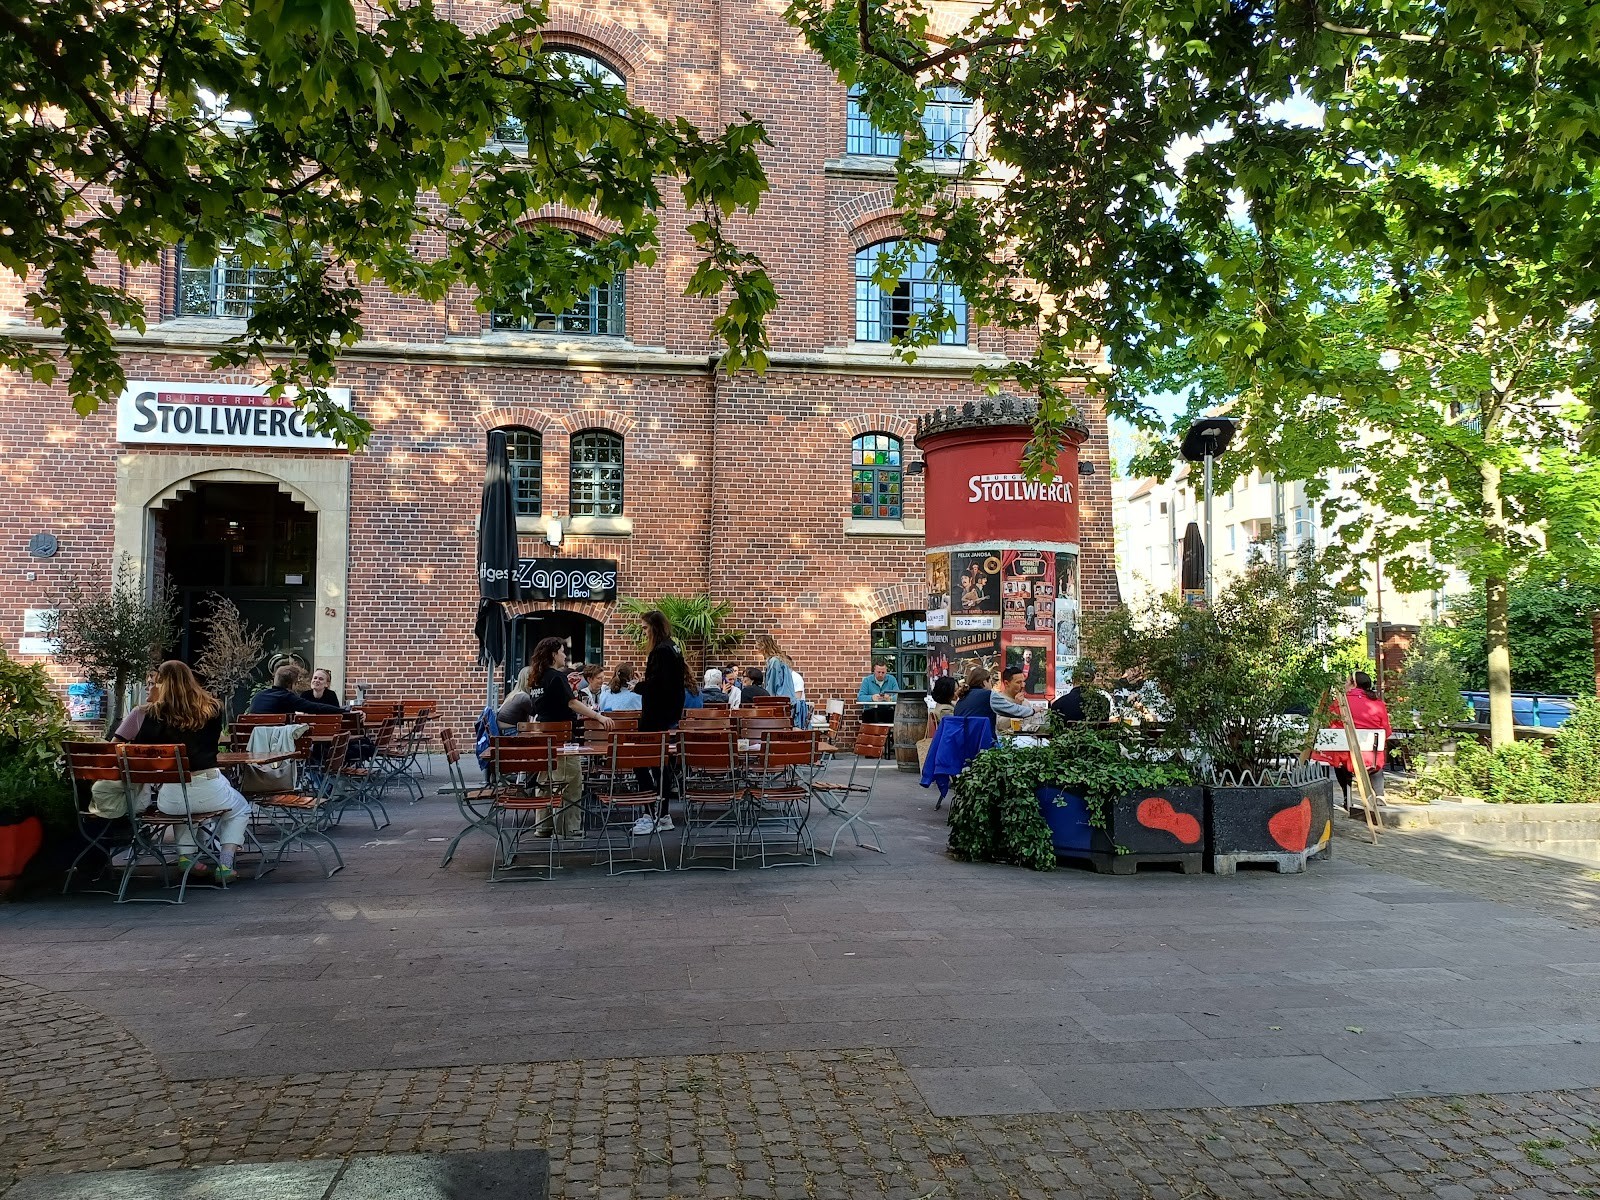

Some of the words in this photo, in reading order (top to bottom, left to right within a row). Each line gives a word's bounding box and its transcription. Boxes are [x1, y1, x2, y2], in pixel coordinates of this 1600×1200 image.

[165, 393, 284, 406] BÜRGERHAU
[519, 559, 617, 598] Zappes
[324, 606, 336, 618] 23
